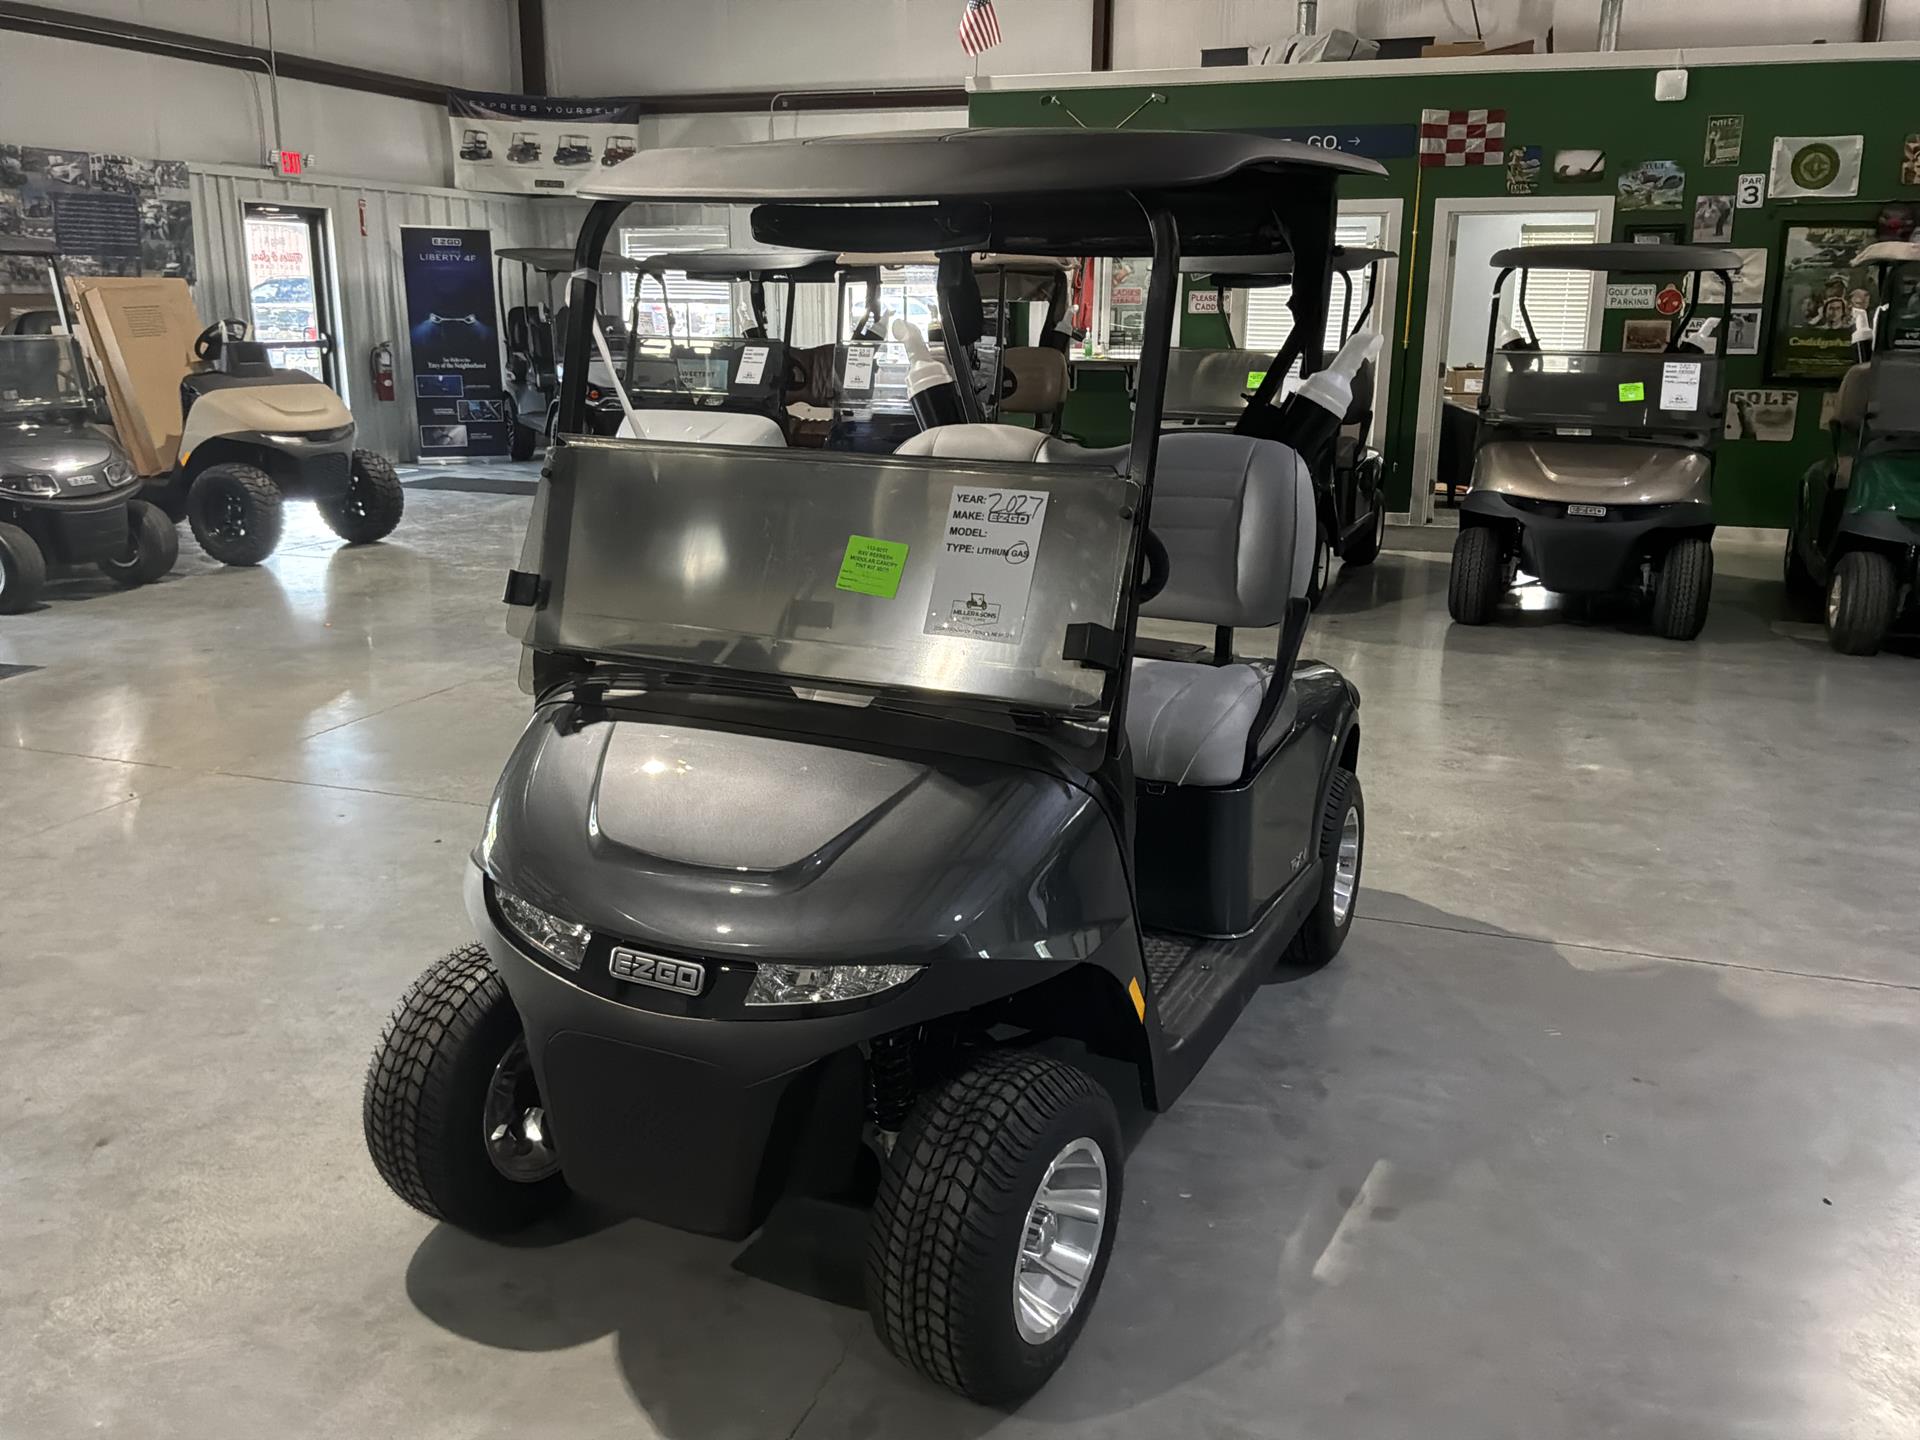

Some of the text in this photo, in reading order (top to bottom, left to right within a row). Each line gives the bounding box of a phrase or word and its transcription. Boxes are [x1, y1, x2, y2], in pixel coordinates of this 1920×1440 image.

[469, 100, 621, 114] EXPRESS YOURSELF
[1308, 135, 1342, 150] GO.
[281, 152, 302, 174] EXIT
[1741, 177, 1762, 185] PAR
[1742, 185, 1759, 205] 3
[419, 253, 460, 261] LIBERTY
[1192, 294, 1217, 302] PLEASE
[1608, 287, 1653, 296] GOLF CART
[1195, 303, 1217, 311] CADD
[1610, 298, 1649, 306] PARKING
[1789, 337, 1852, 349] Caddysha
[1730, 391, 1798, 408] GOLF
[957, 494, 987, 504] YEAR:
[988, 493, 1044, 520] 2027
[952, 510, 1029, 525] MAKE: EZGO
[949, 527, 987, 538] MODEL:
[946, 543, 1029, 558] TYPE: LITHIUM GAS
[613, 951, 699, 991] EZGO
